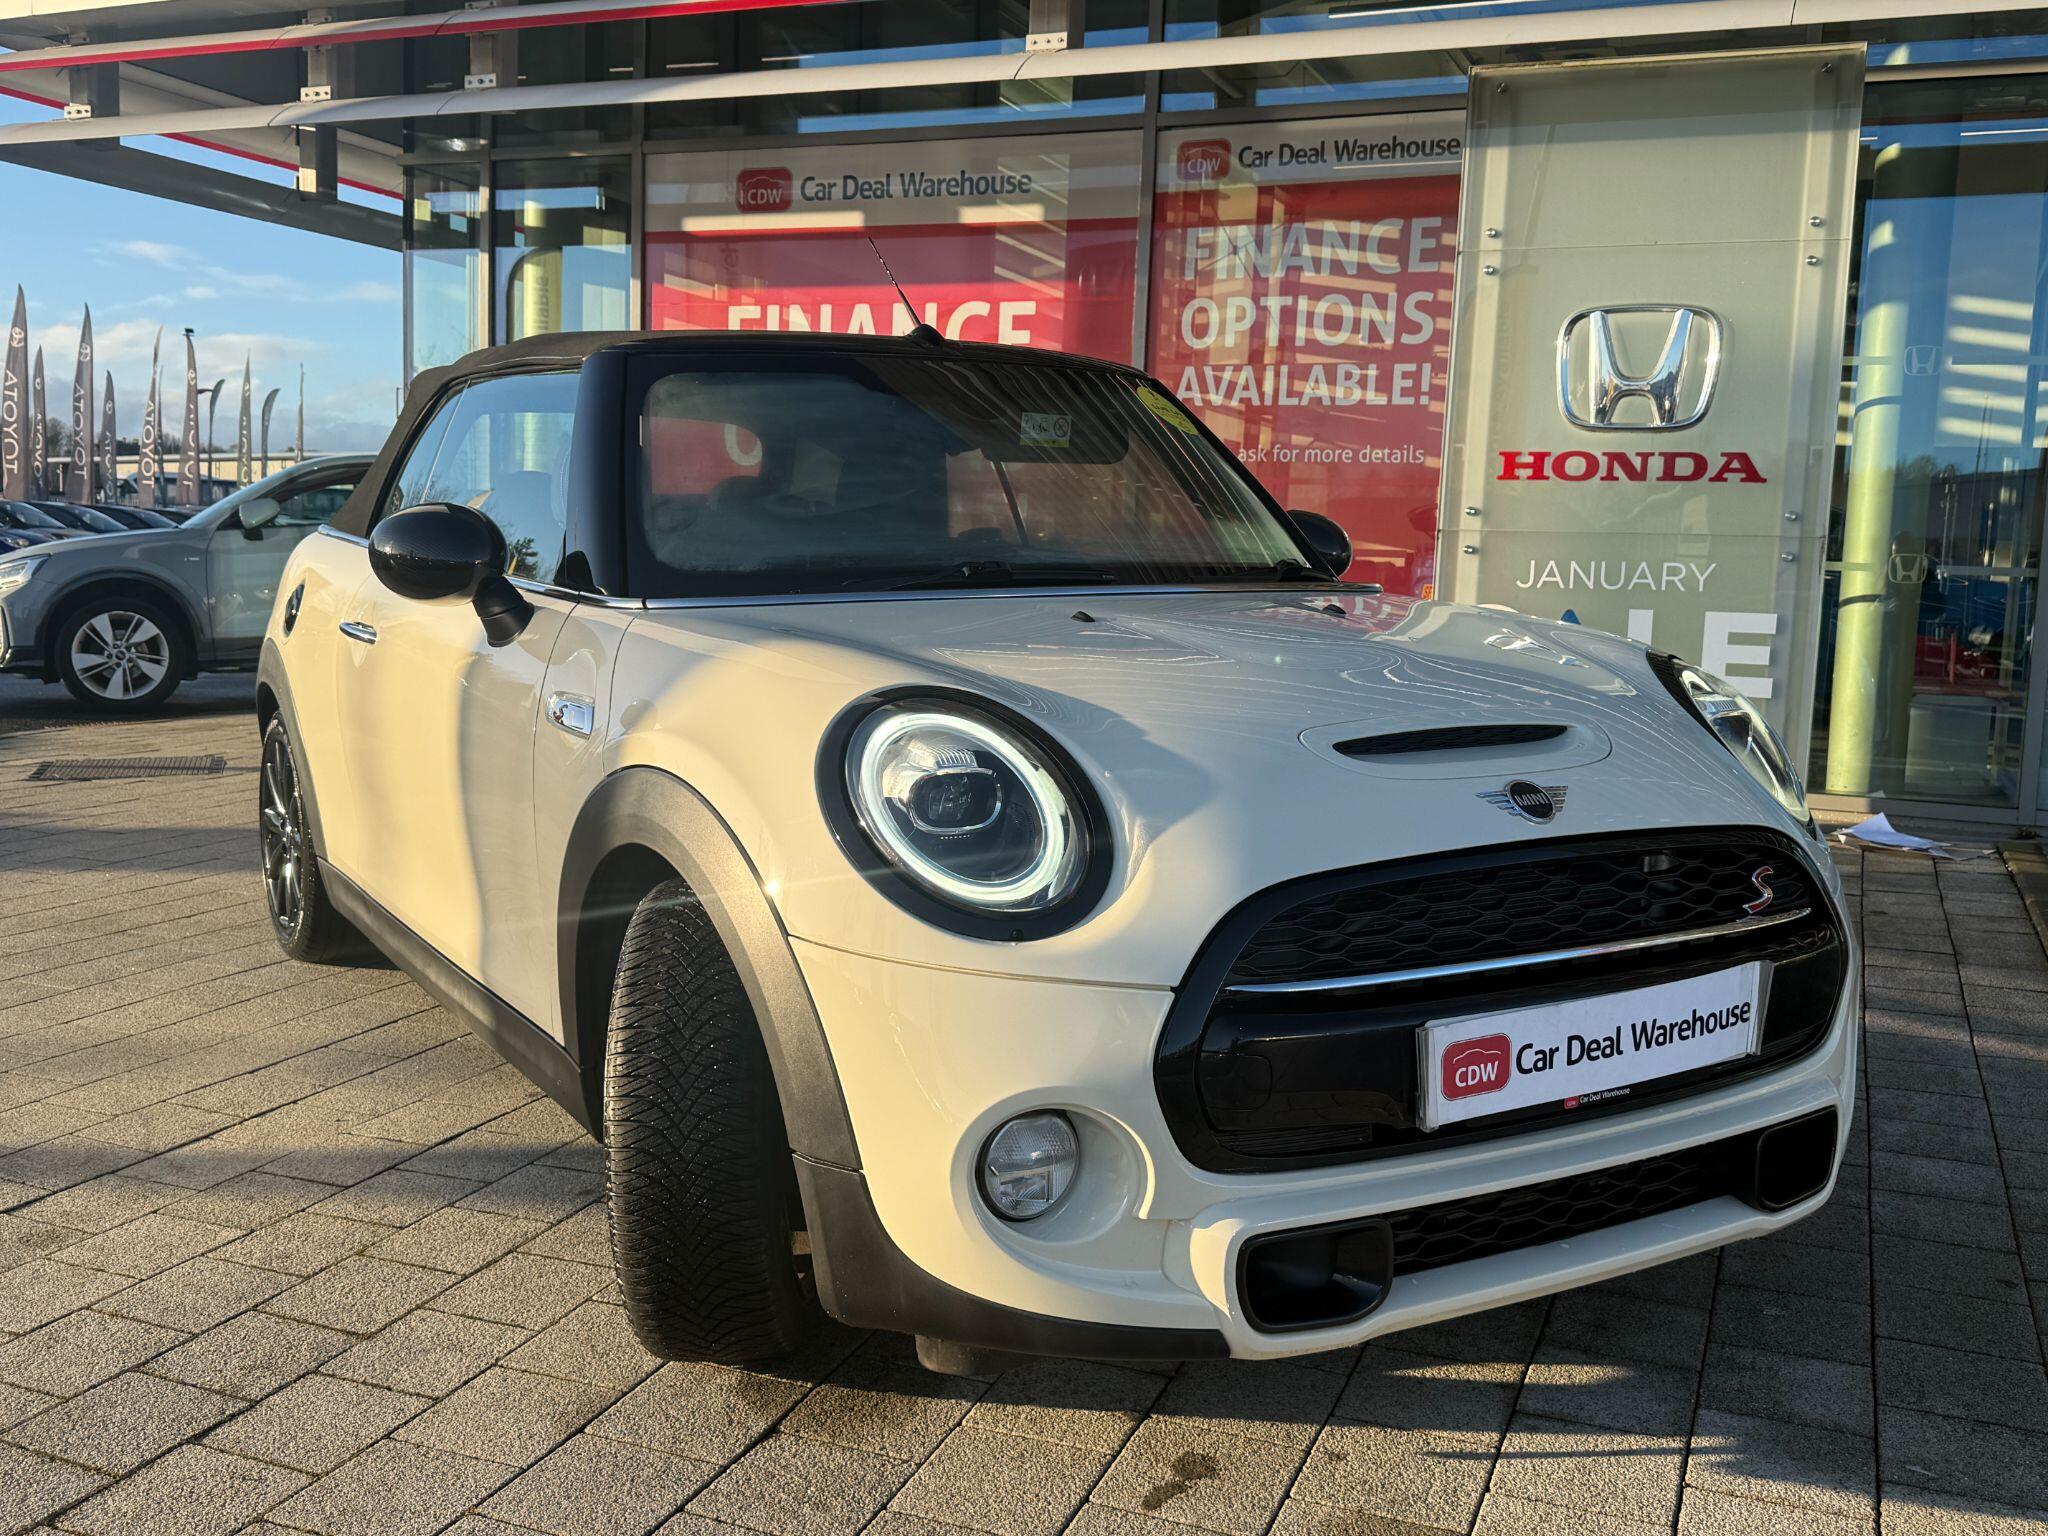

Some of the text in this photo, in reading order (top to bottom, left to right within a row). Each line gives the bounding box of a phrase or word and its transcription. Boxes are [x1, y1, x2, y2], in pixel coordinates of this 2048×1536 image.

[1187, 157, 1220, 174] CDW
[1238, 136, 1461, 169] Car Deal Warehouse
[747, 187, 783, 205] CDW
[800, 170, 1032, 202] Car Deal Warehouse
[1184, 217, 1442, 281] FINANCE
[1181, 291, 1435, 349] OPTIONS
[1176, 362, 1432, 407] AVAILABLE!
[1237, 444, 1425, 463] ask for more details
[1496, 450, 1768, 484] HONDA
[1515, 559, 1717, 593] JANUARY
[1514, 792, 1550, 807] MINI
[1742, 865, 1774, 914] S
[1515, 1000, 1752, 1076] Car Deal Warehouse
[1454, 1060, 1499, 1088] CDW
[1580, 1087, 1631, 1104] Car Deal Warehouse
